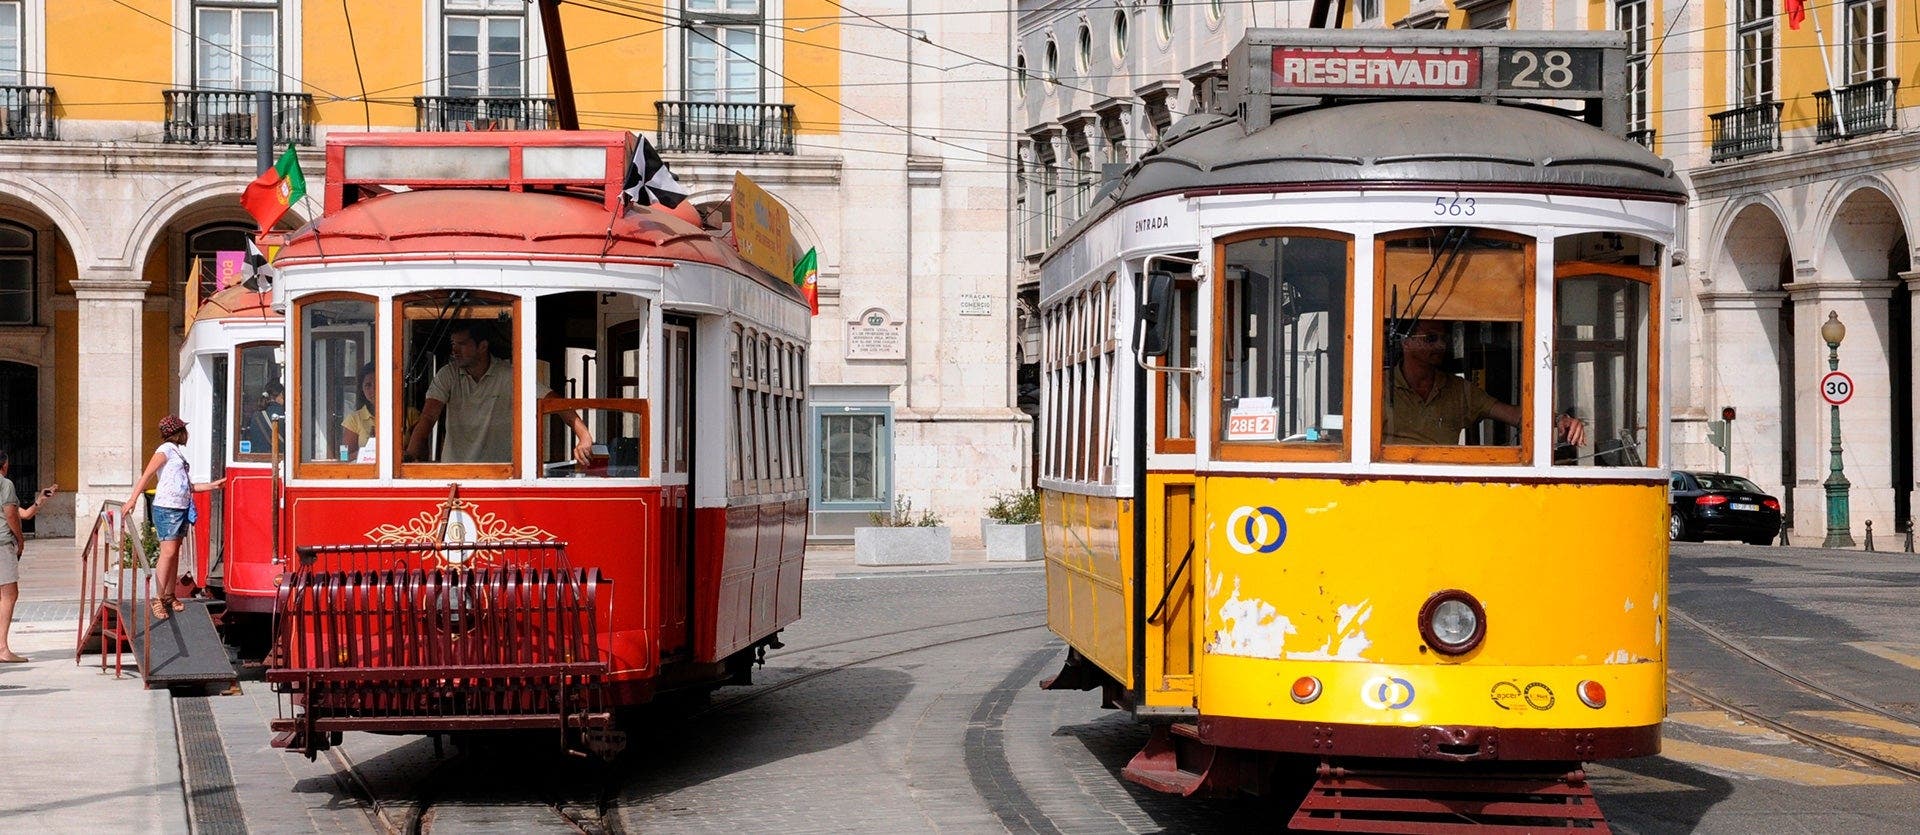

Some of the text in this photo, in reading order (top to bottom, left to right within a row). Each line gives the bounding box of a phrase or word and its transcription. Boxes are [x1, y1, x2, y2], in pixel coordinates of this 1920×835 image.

[1283, 57, 1468, 87] RESERVADO
[1510, 49, 1574, 88] 28
[1434, 196, 1476, 216] 563
[1135, 215, 1169, 233] ENTRADA
[1826, 381, 1848, 395] 30
[1230, 418, 1271, 433] 28E 2
